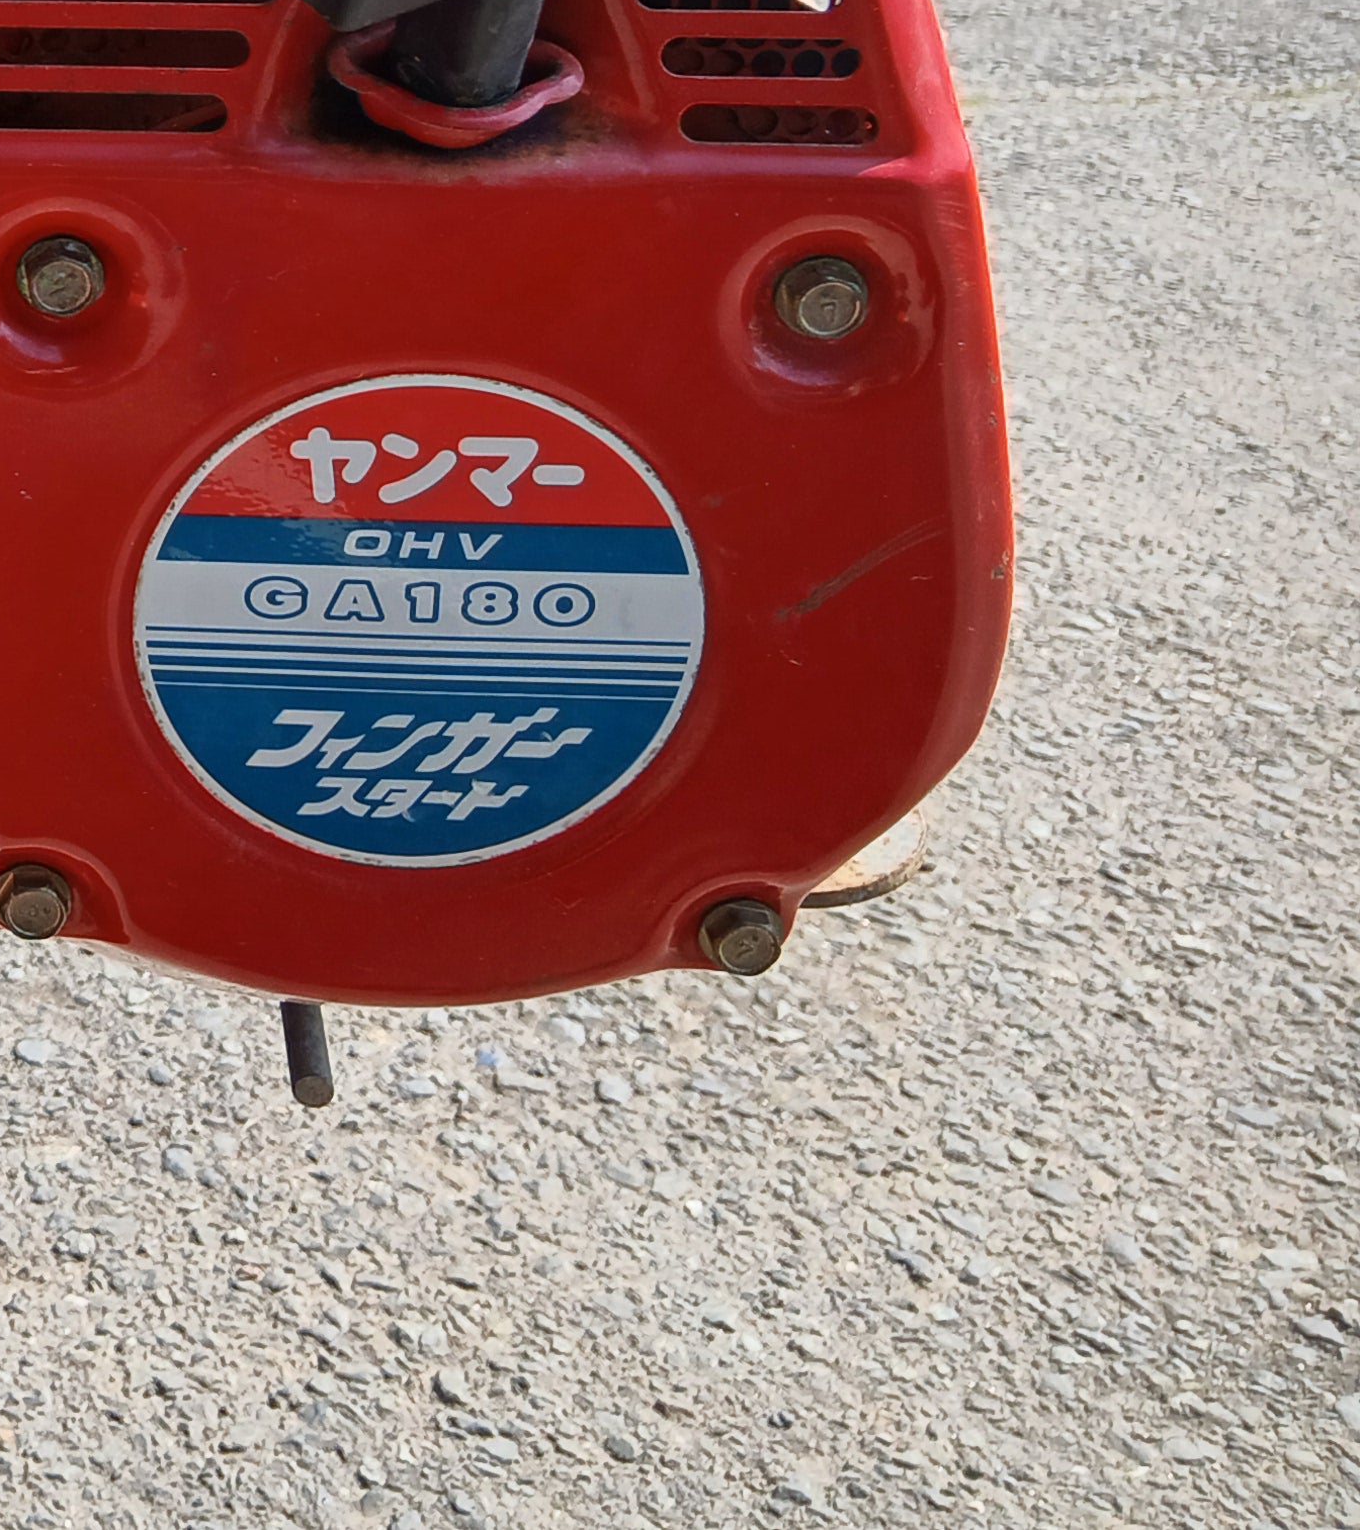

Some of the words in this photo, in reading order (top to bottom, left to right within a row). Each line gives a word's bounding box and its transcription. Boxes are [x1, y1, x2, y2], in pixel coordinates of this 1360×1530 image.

[290, 426, 585, 507] ヤンマー
[343, 529, 503, 560] OHV
[244, 576, 596, 627] GA180
[245, 708, 593, 773] フィンガー
[297, 775, 528, 820] スタート
